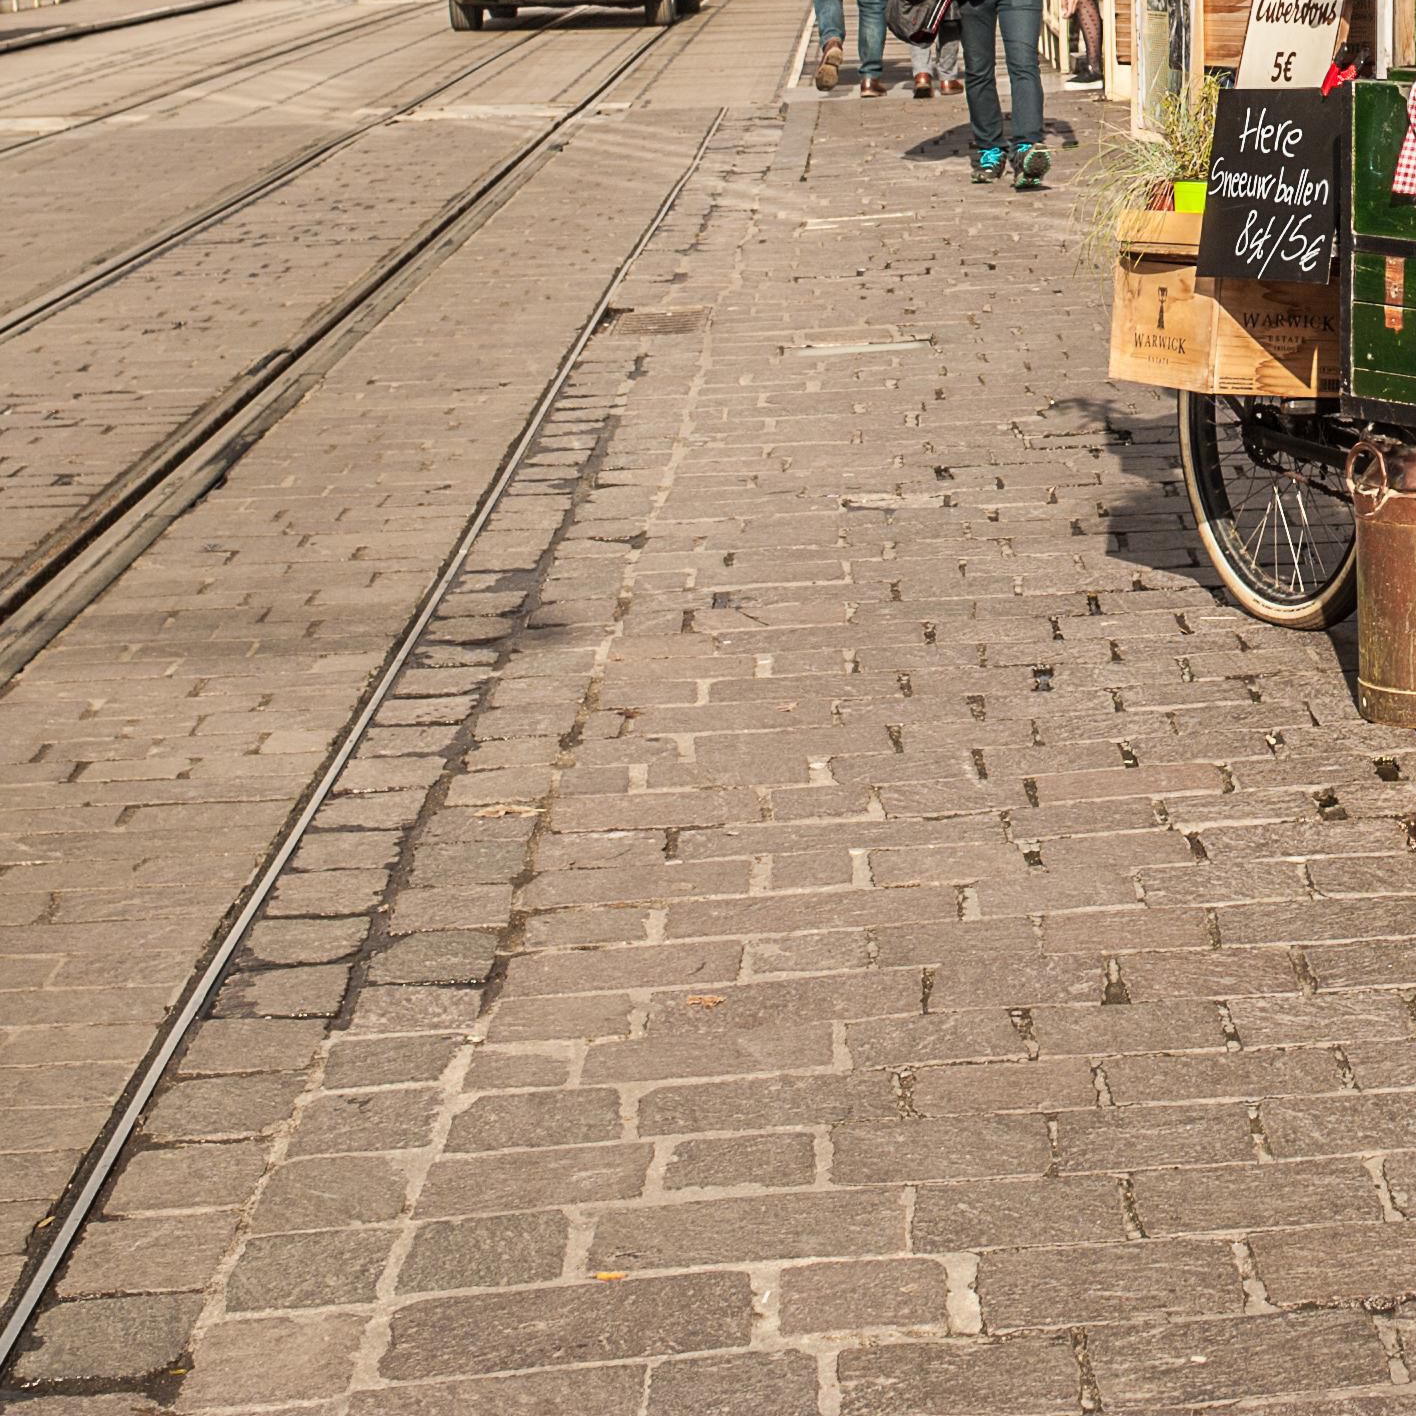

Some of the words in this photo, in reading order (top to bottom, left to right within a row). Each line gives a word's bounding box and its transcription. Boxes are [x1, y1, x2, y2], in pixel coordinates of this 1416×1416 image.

[1271, 51, 1297, 82] 5€
[1238, 107, 1303, 158] Here
[1243, 312, 1336, 332] WARWICK
[1134, 332, 1187, 355] WARWICK
